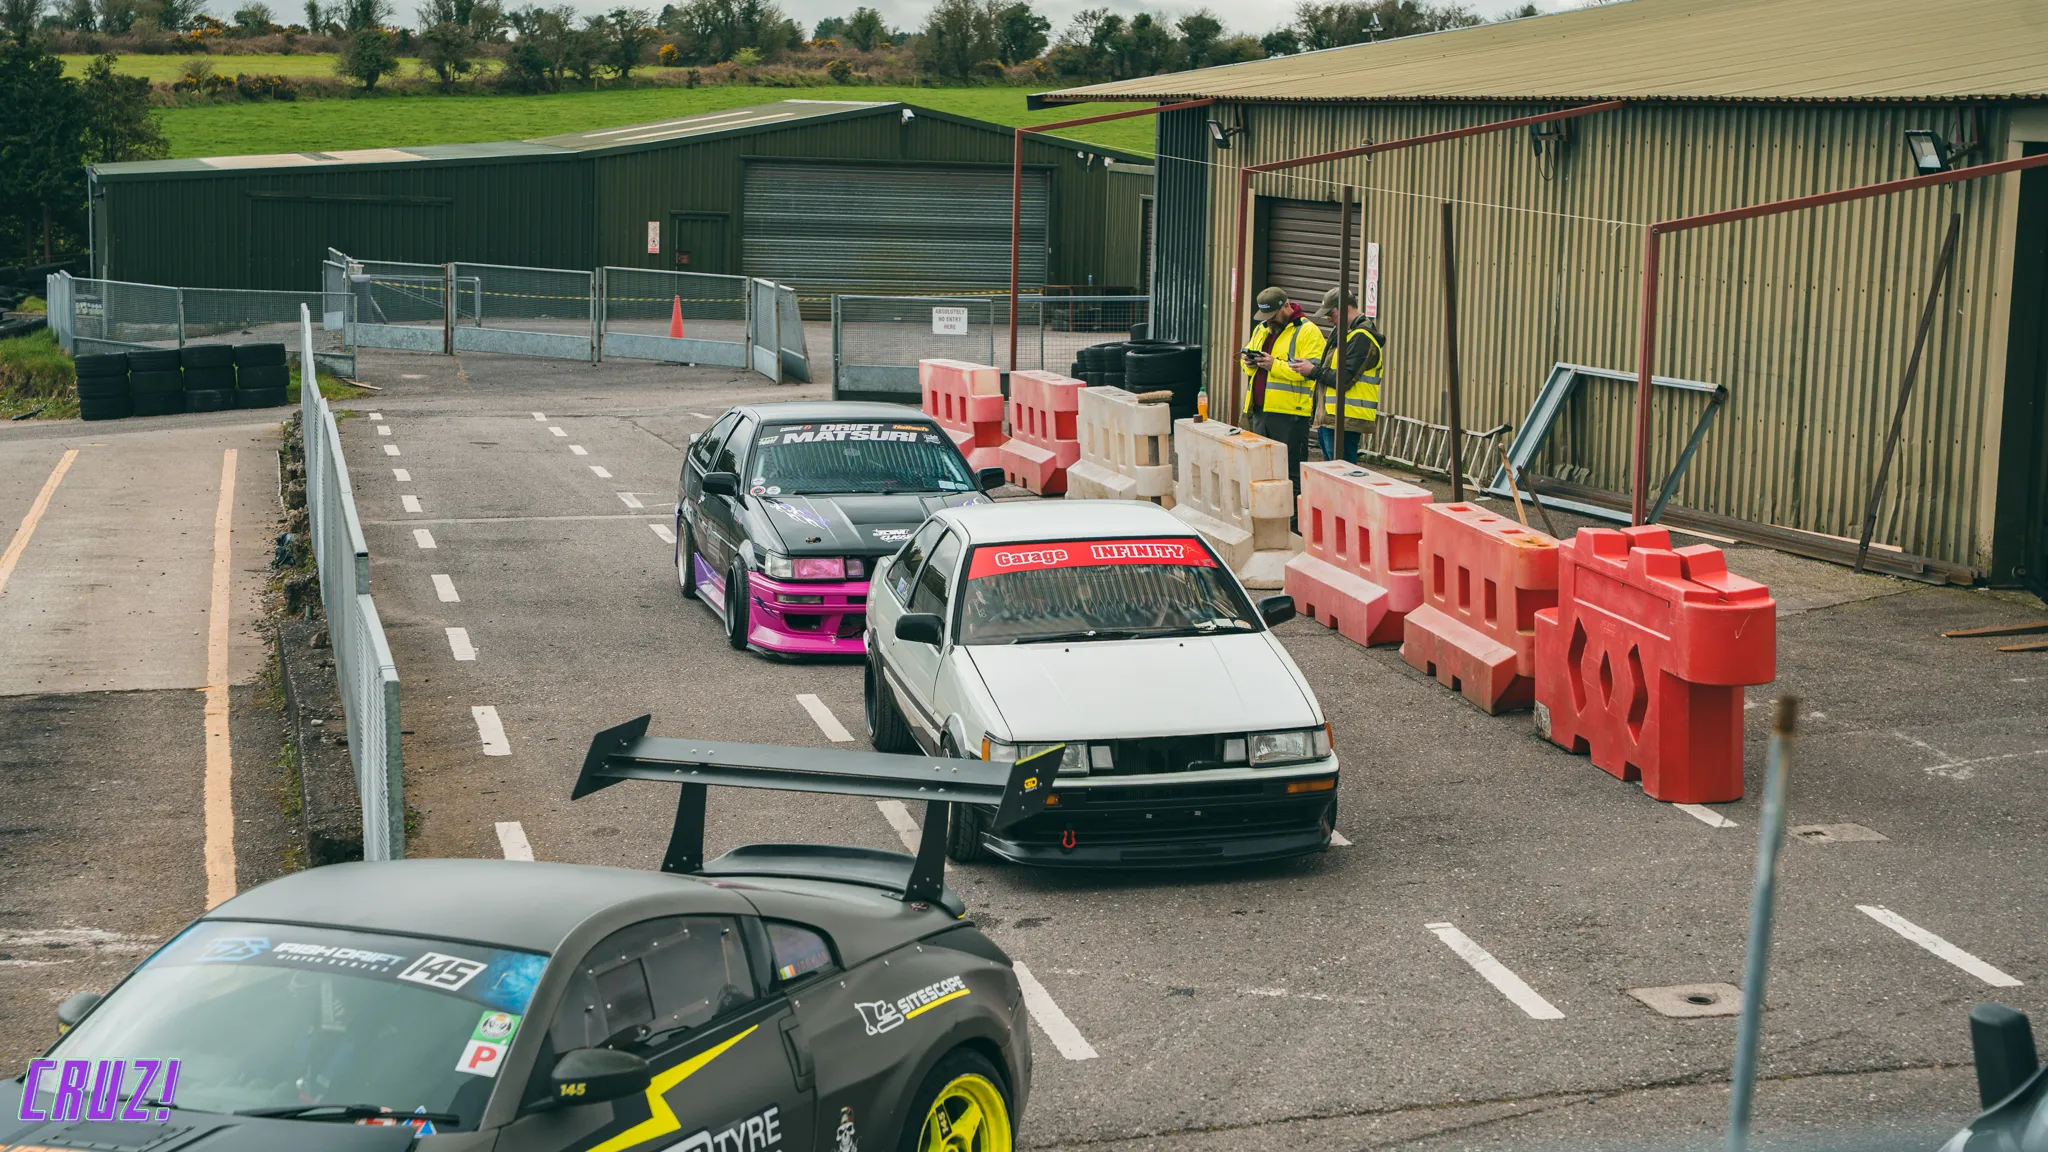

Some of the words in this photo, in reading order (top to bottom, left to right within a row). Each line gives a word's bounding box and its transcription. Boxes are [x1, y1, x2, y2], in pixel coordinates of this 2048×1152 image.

[783, 430, 918, 445] MATSURI
[820, 423, 884, 432] DRIFT
[995, 549, 1068, 567] Garage
[1091, 544, 1184, 559] INFINITY
[272, 942, 339, 957] IRISH
[332, 948, 409, 966] DRIFT
[404, 953, 484, 990] 145
[897, 975, 966, 1015] SITESCAPE
[468, 1045, 497, 1069] P
[559, 1082, 586, 1096] 145
[713, 1106, 782, 1152] TYRE
